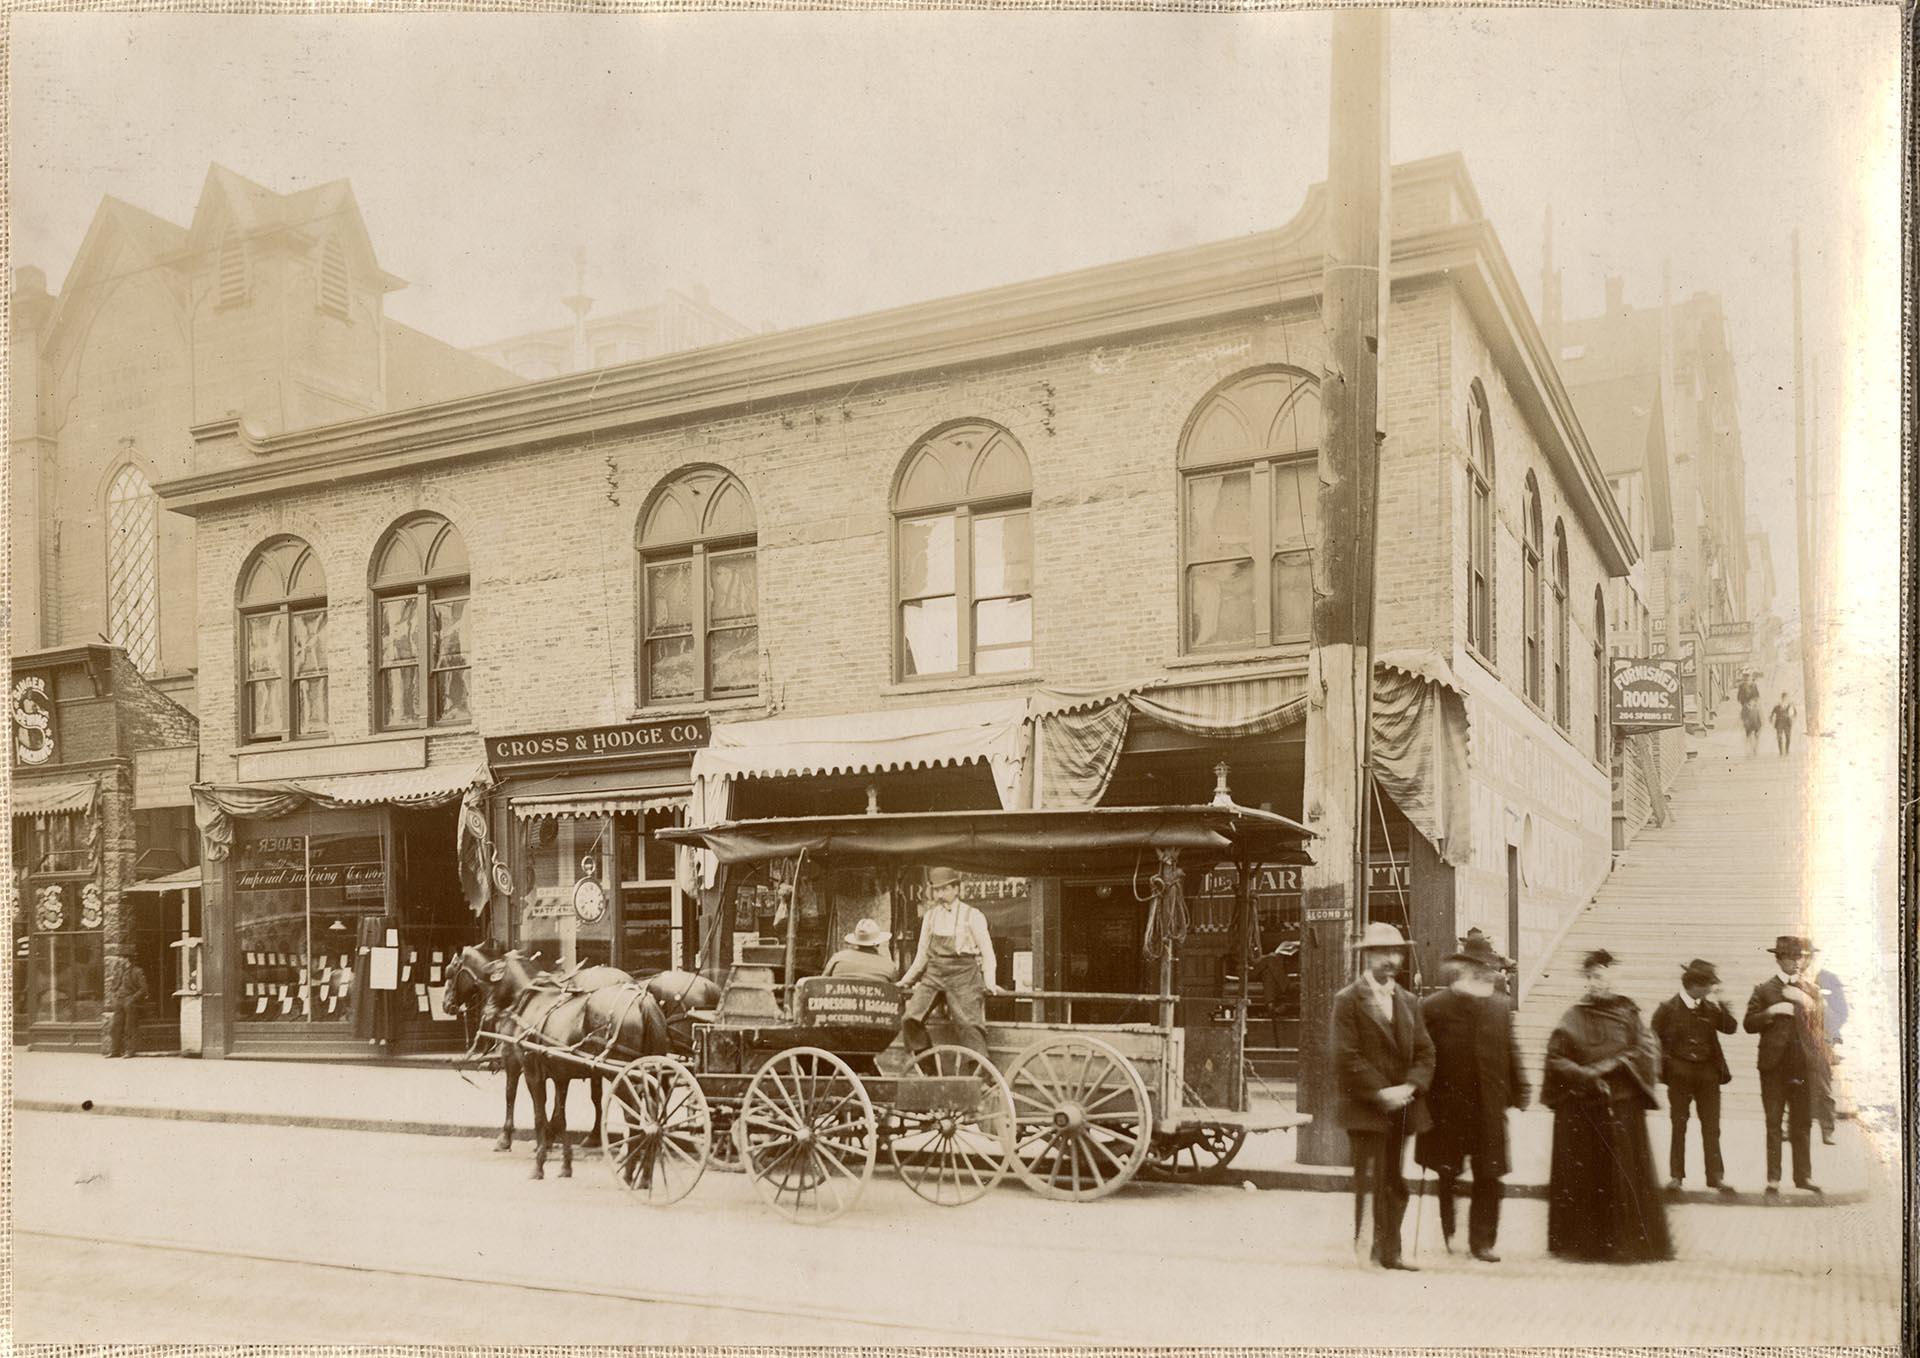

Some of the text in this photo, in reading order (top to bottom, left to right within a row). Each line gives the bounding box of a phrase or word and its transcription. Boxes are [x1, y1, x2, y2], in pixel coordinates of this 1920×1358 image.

[12, 676, 46, 701] SINGER
[1613, 665, 1678, 693] FURNISHED
[1622, 690, 1669, 708] ROOMS
[497, 725, 703, 757] CROSS & HODGE CO.
[1306, 910, 1341, 921] SECOND
[827, 1013, 873, 1024] OCCIDENTAL
